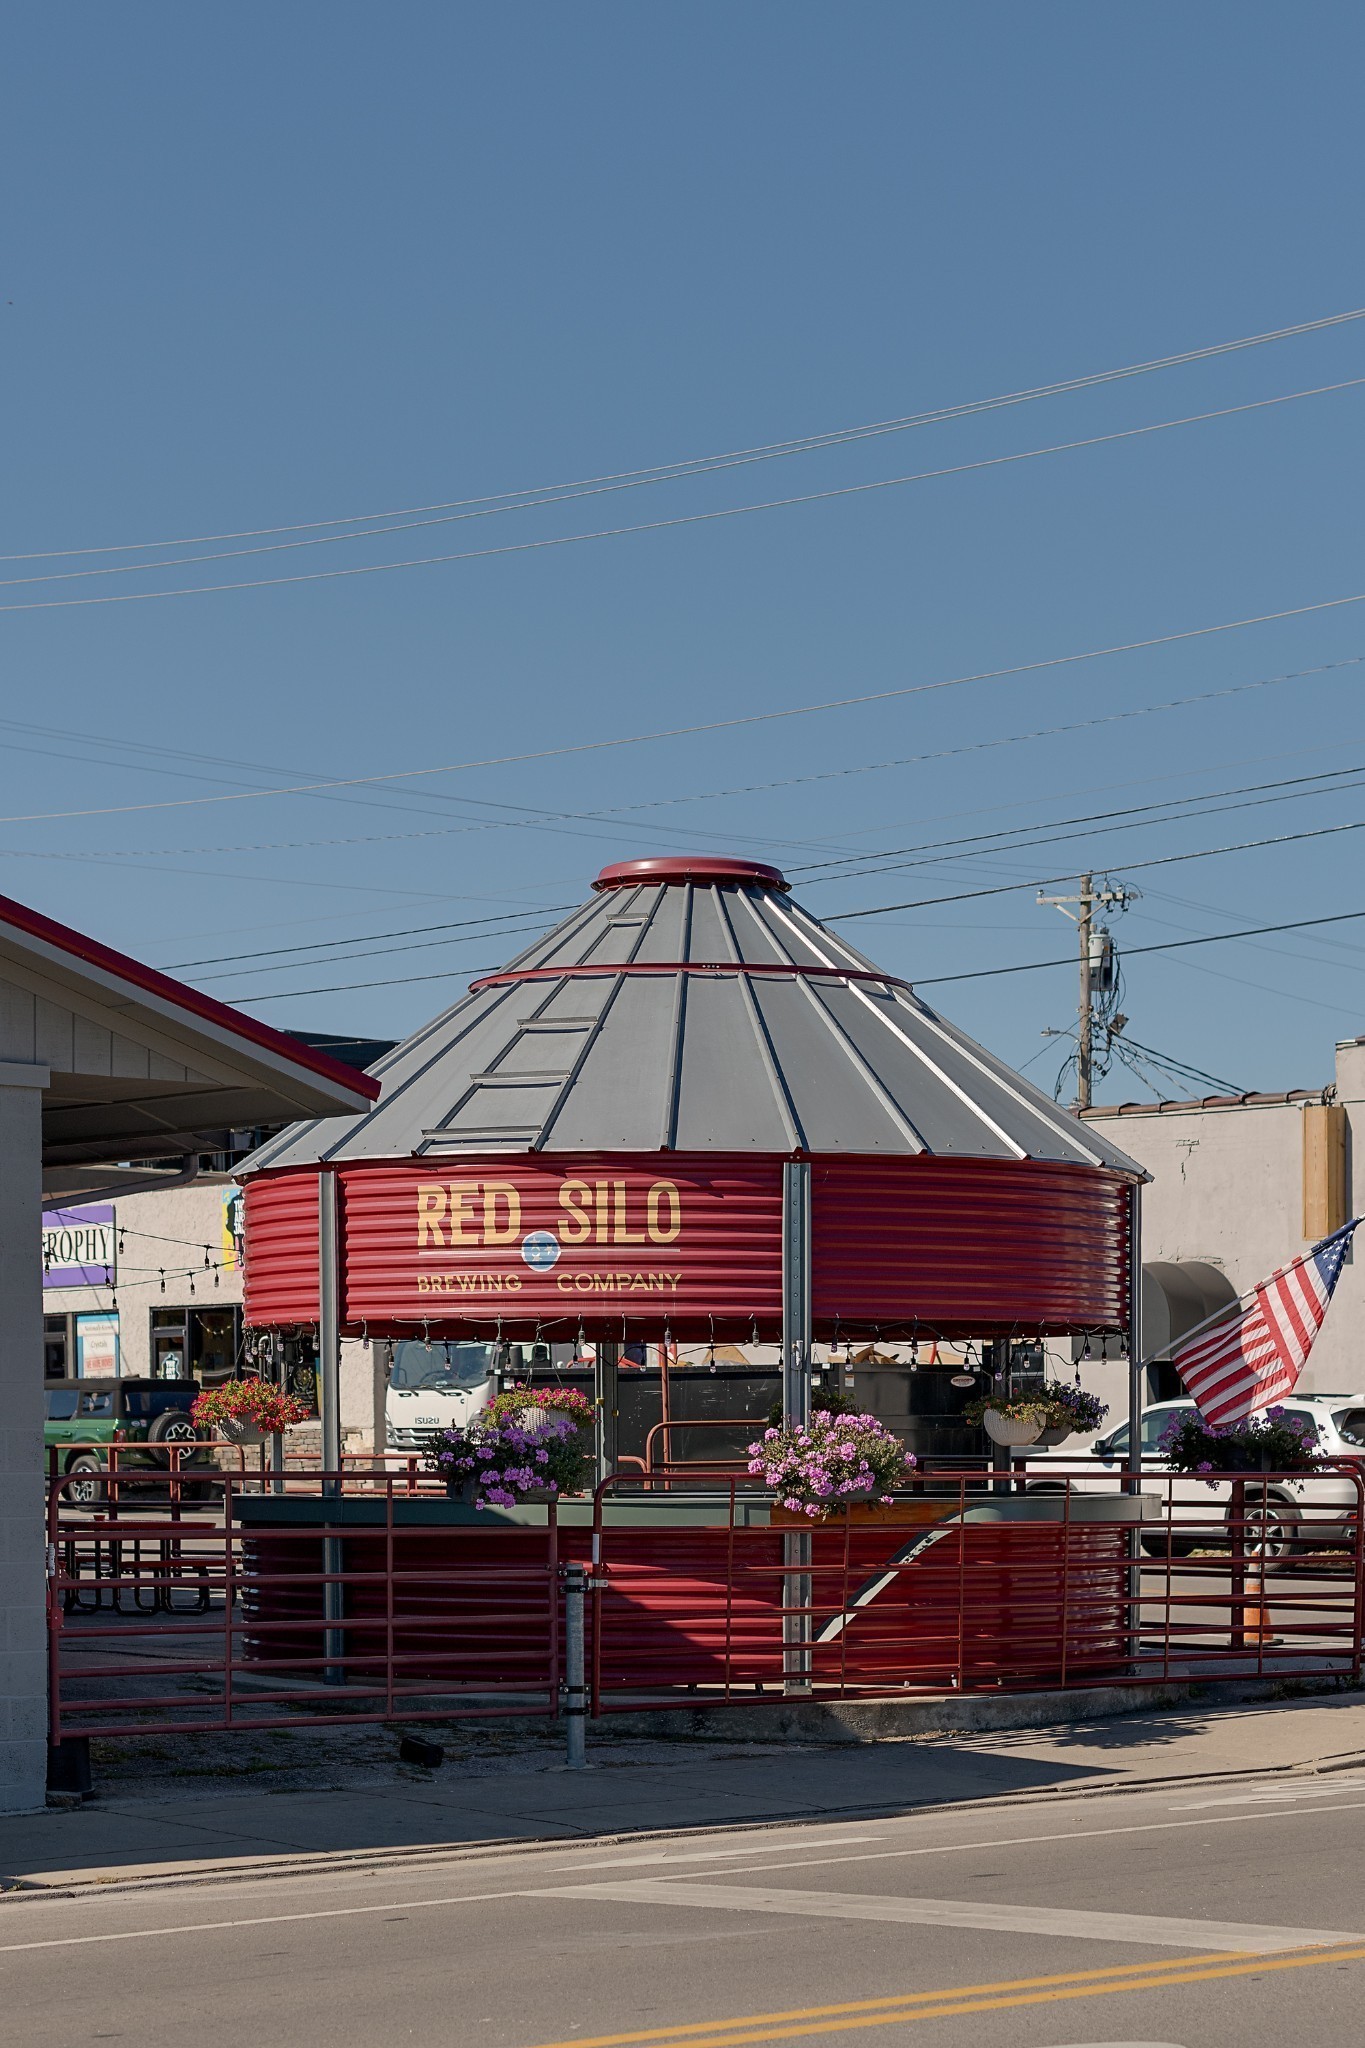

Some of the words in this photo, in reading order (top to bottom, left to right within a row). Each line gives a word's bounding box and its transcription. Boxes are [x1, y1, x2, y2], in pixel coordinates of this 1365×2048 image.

[417, 1182, 521, 1246] RED
[557, 1180, 681, 1244] SILO
[43, 1229, 110, 1263] ROPHY
[417, 1273, 523, 1293] BREWING
[557, 1273, 683, 1292] COMPANY
[415, 1416, 440, 1425] ISUZU
